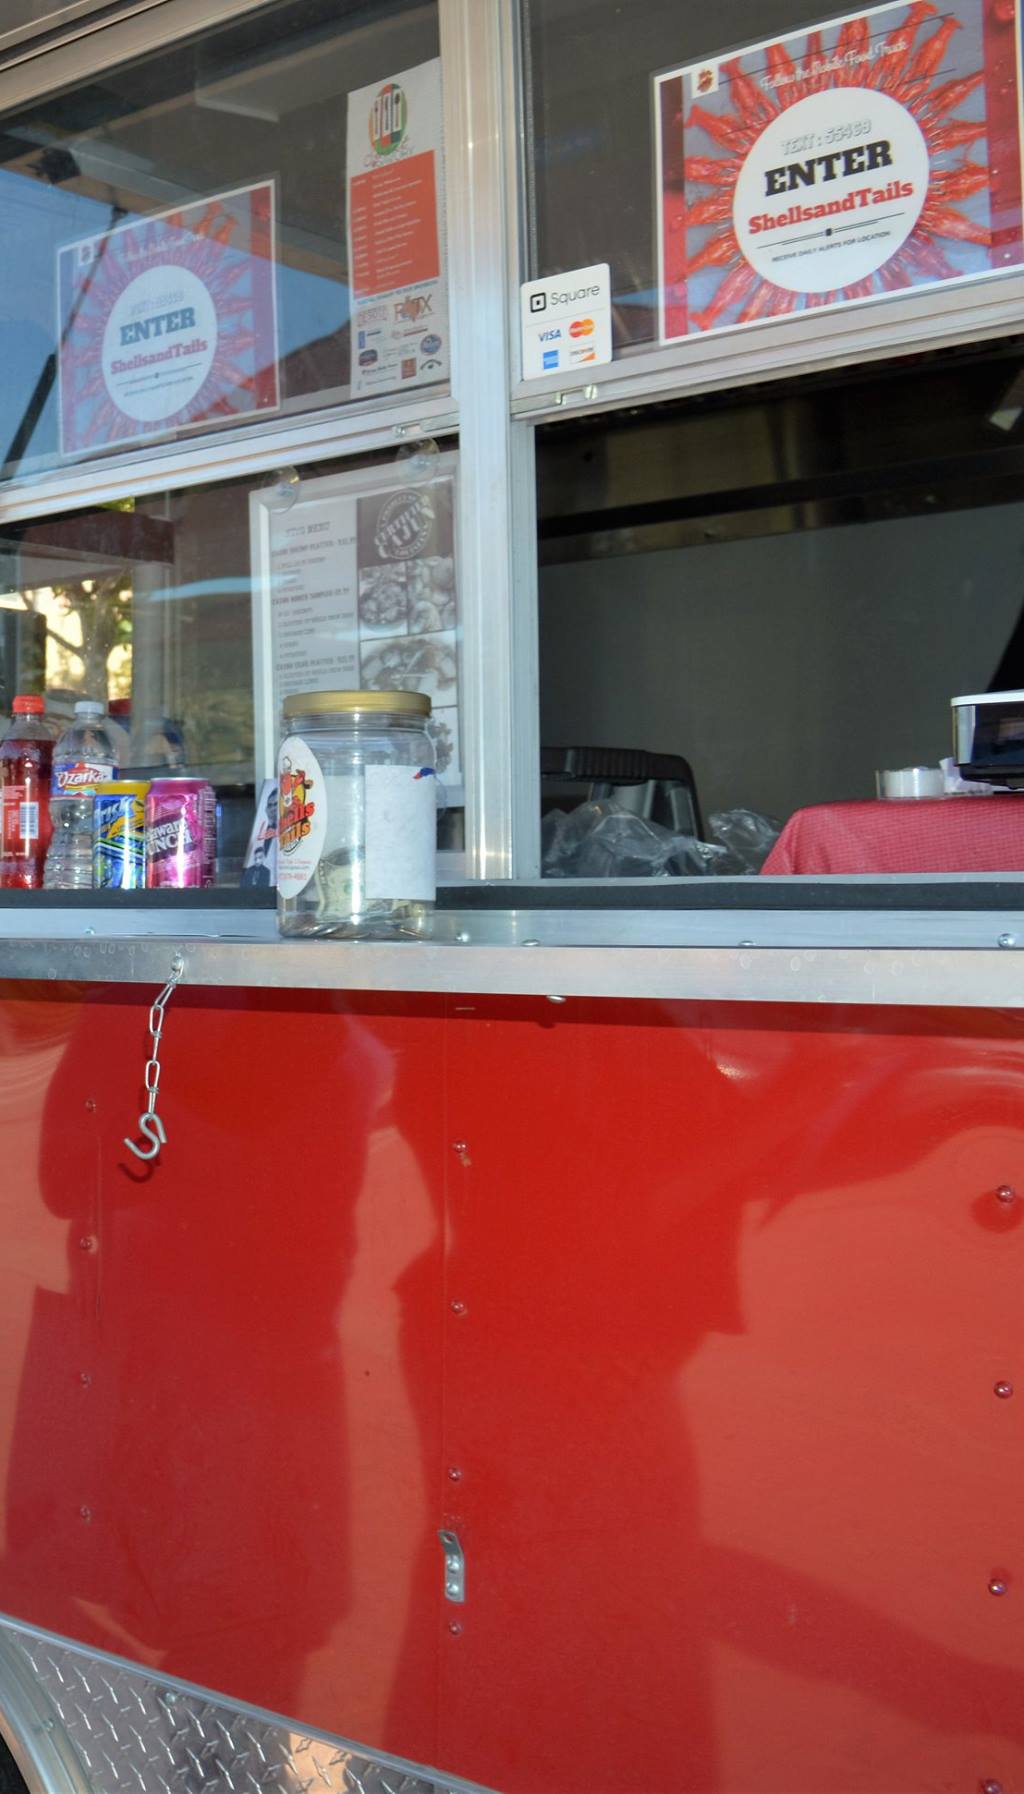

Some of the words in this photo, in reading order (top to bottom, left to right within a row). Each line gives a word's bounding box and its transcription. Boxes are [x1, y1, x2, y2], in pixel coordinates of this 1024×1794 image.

[764, 140, 893, 197] ENTER
[748, 180, 913, 234] ShellsandTails
[550, 285, 600, 306] Square
[120, 307, 196, 346] ENTER
[538, 329, 562, 342] VISA
[110, 339, 208, 374] ShellsandTails
[56, 768, 110, 788] Ozarka
